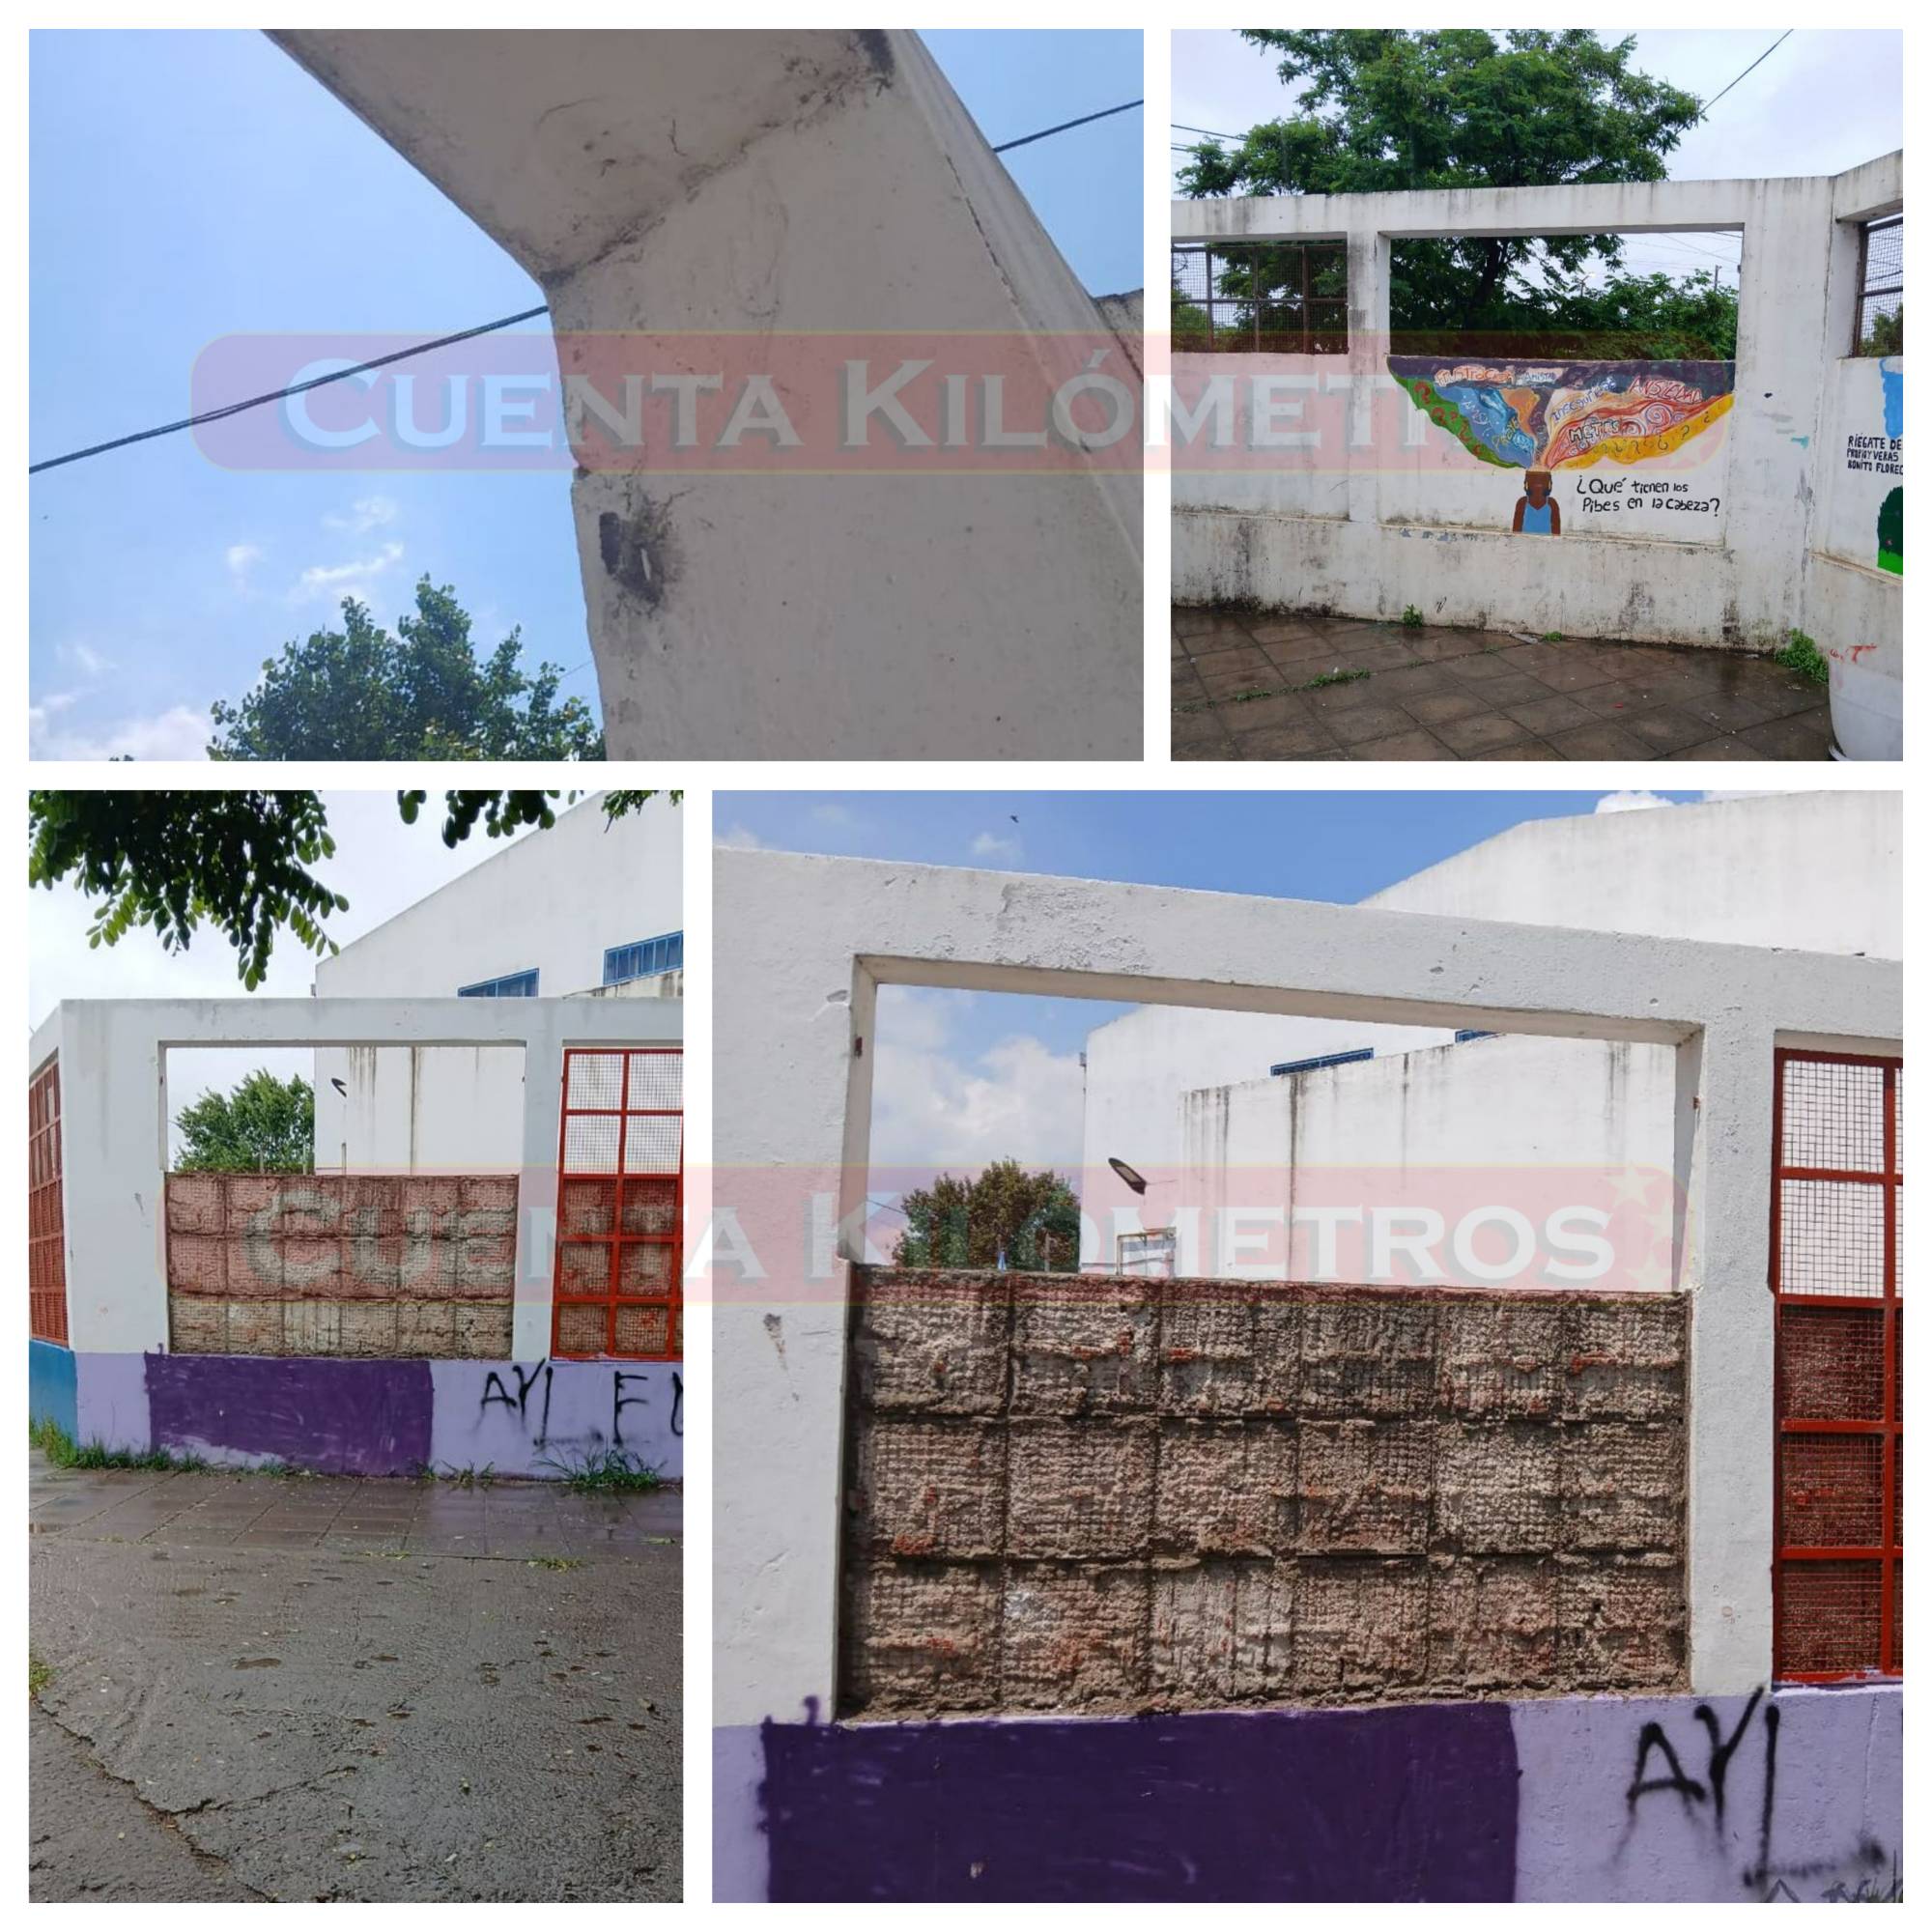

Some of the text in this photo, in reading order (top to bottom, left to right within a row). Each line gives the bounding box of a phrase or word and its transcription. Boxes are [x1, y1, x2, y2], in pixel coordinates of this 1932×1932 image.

[1889, 439, 1902, 451] DE
[1873, 450, 1899, 463] VERAS
[1577, 474, 1689, 495] ¿Qué tienen los
[1582, 497, 1620, 513] Pibes
[1627, 497, 1643, 509] en
[1652, 497, 1663, 509] la
